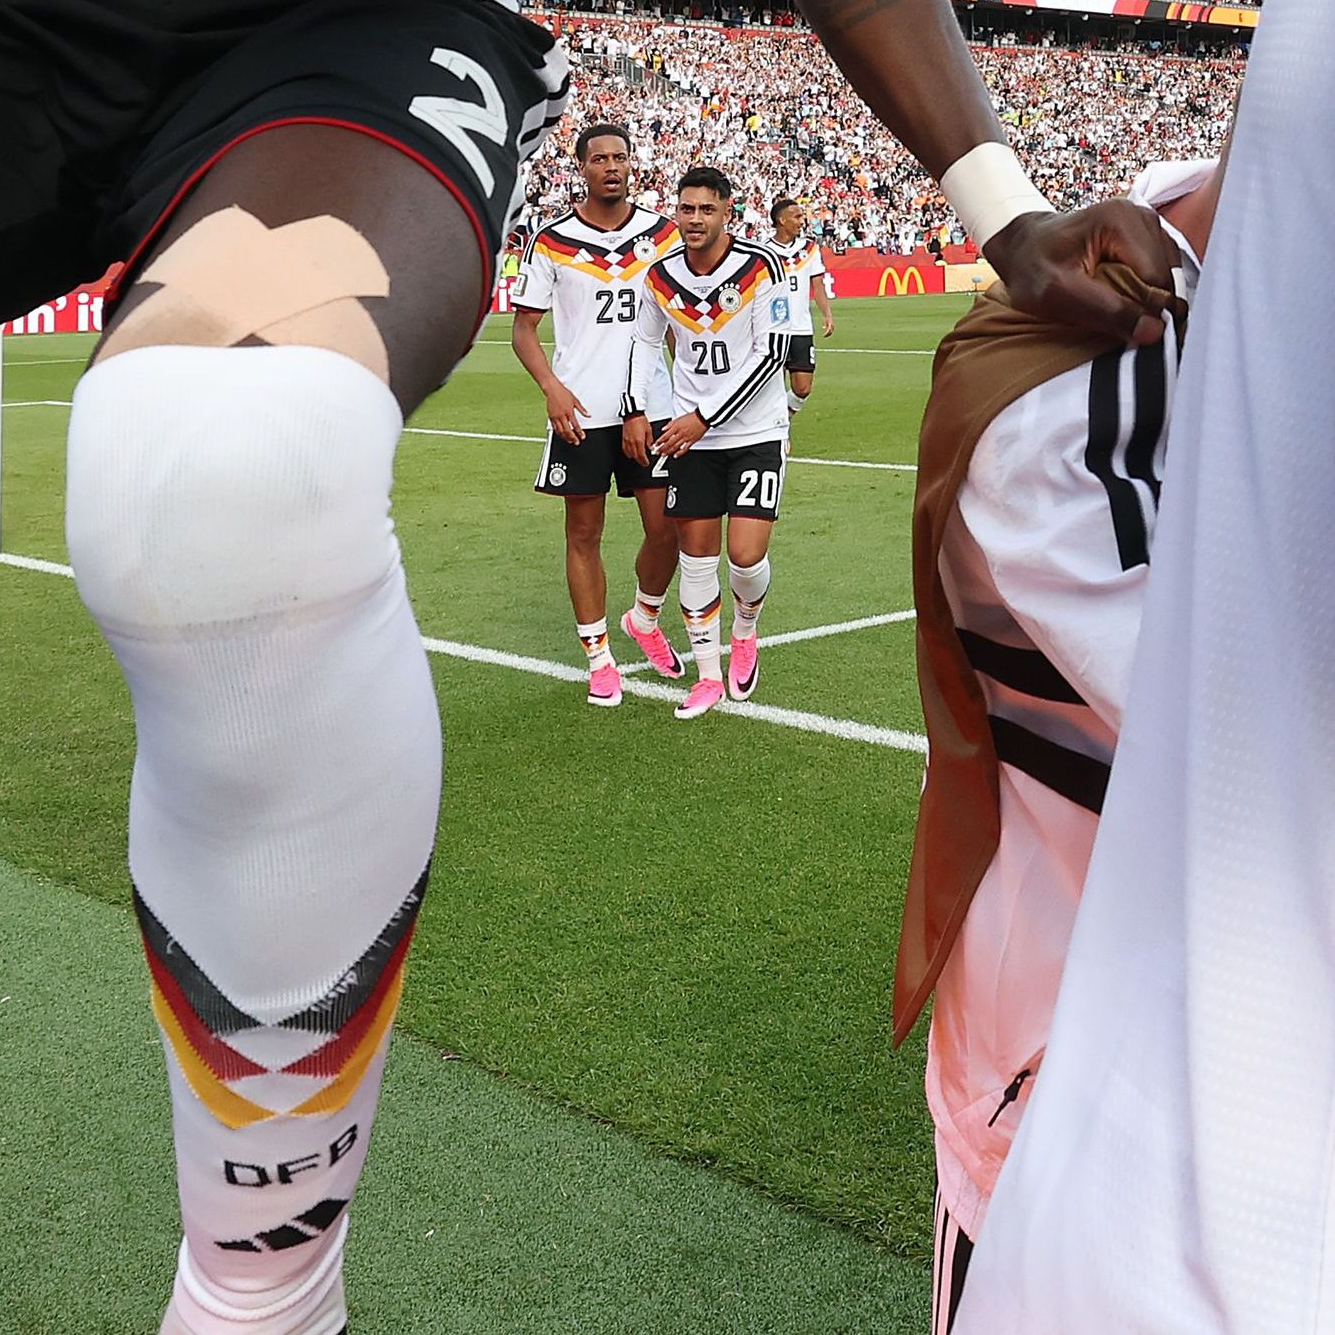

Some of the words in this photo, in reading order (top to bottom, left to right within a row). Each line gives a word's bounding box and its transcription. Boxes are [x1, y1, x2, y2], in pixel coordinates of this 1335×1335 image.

[408, 47, 509, 199] 2
[595, 288, 636, 325] 23
[691, 340, 731, 375] 20
[736, 469, 778, 509] 20
[224, 1123, 358, 1187] DFB
